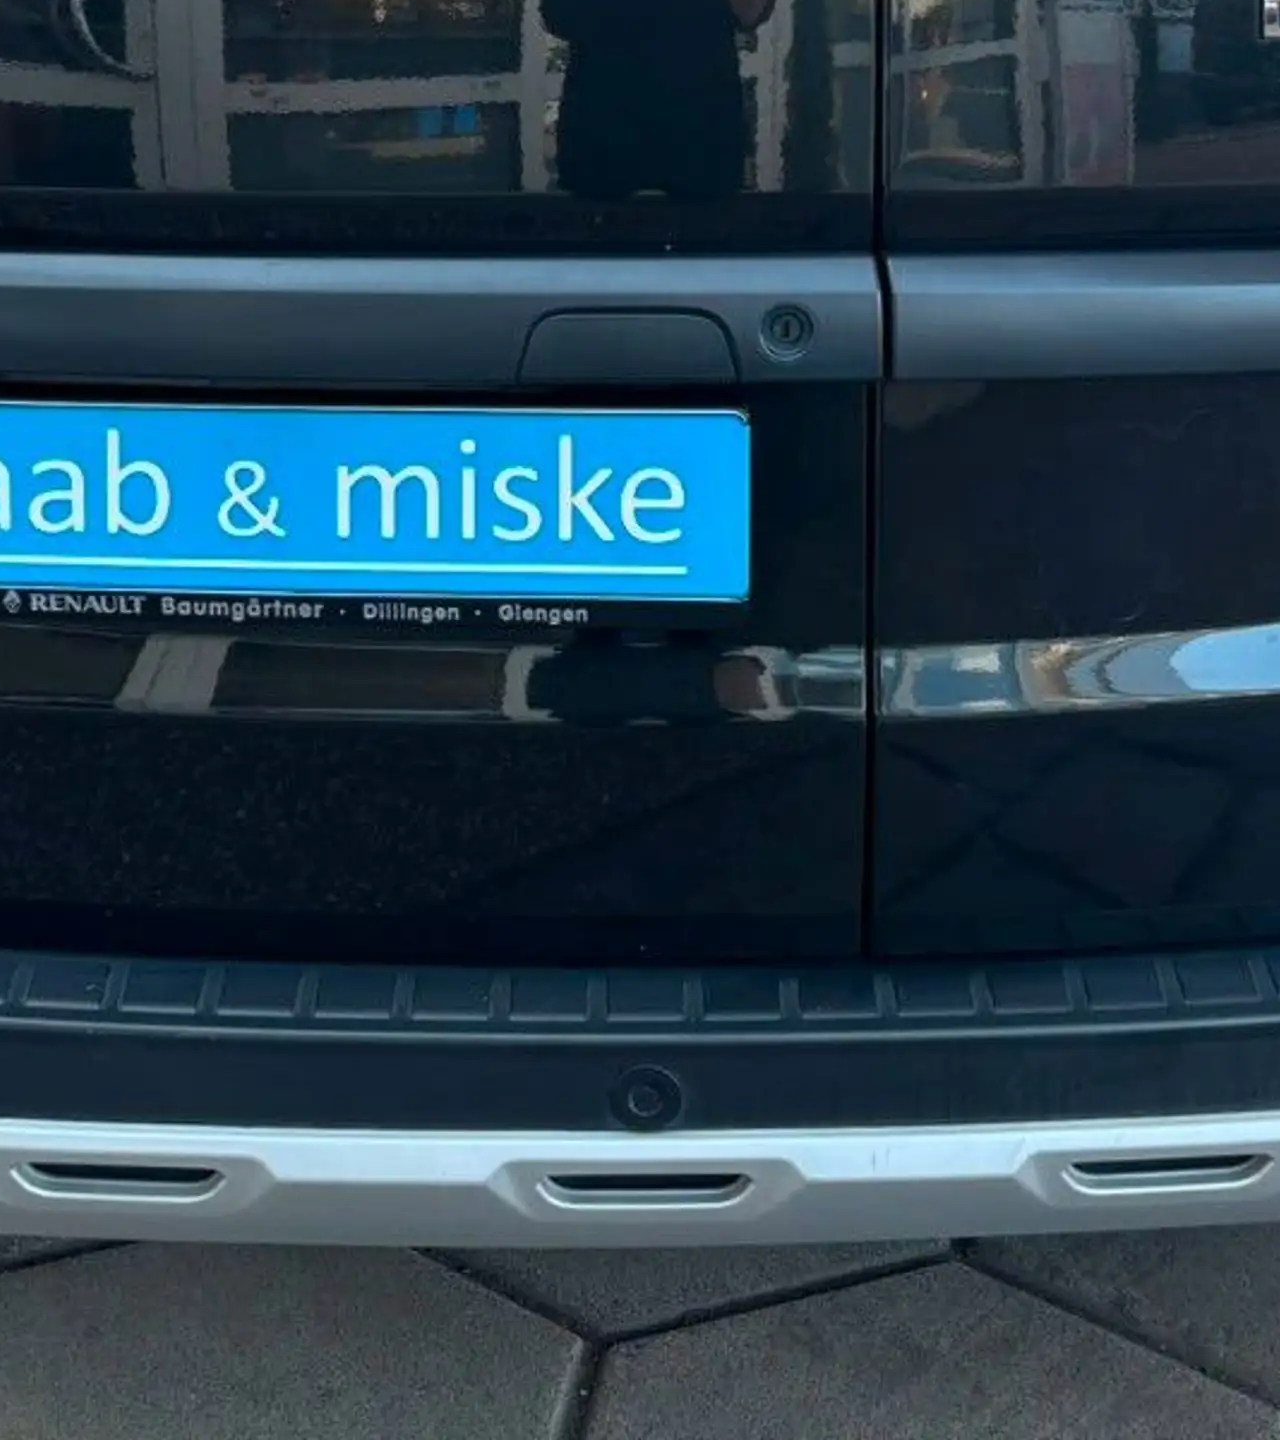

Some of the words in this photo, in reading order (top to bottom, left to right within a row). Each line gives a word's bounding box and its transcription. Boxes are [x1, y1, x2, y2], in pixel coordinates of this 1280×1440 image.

[217, 459, 286, 537] &
[336, 434, 685, 543] miske
[29, 592, 147, 615] RENAULT
[161, 595, 325, 622] Baumgärtner
